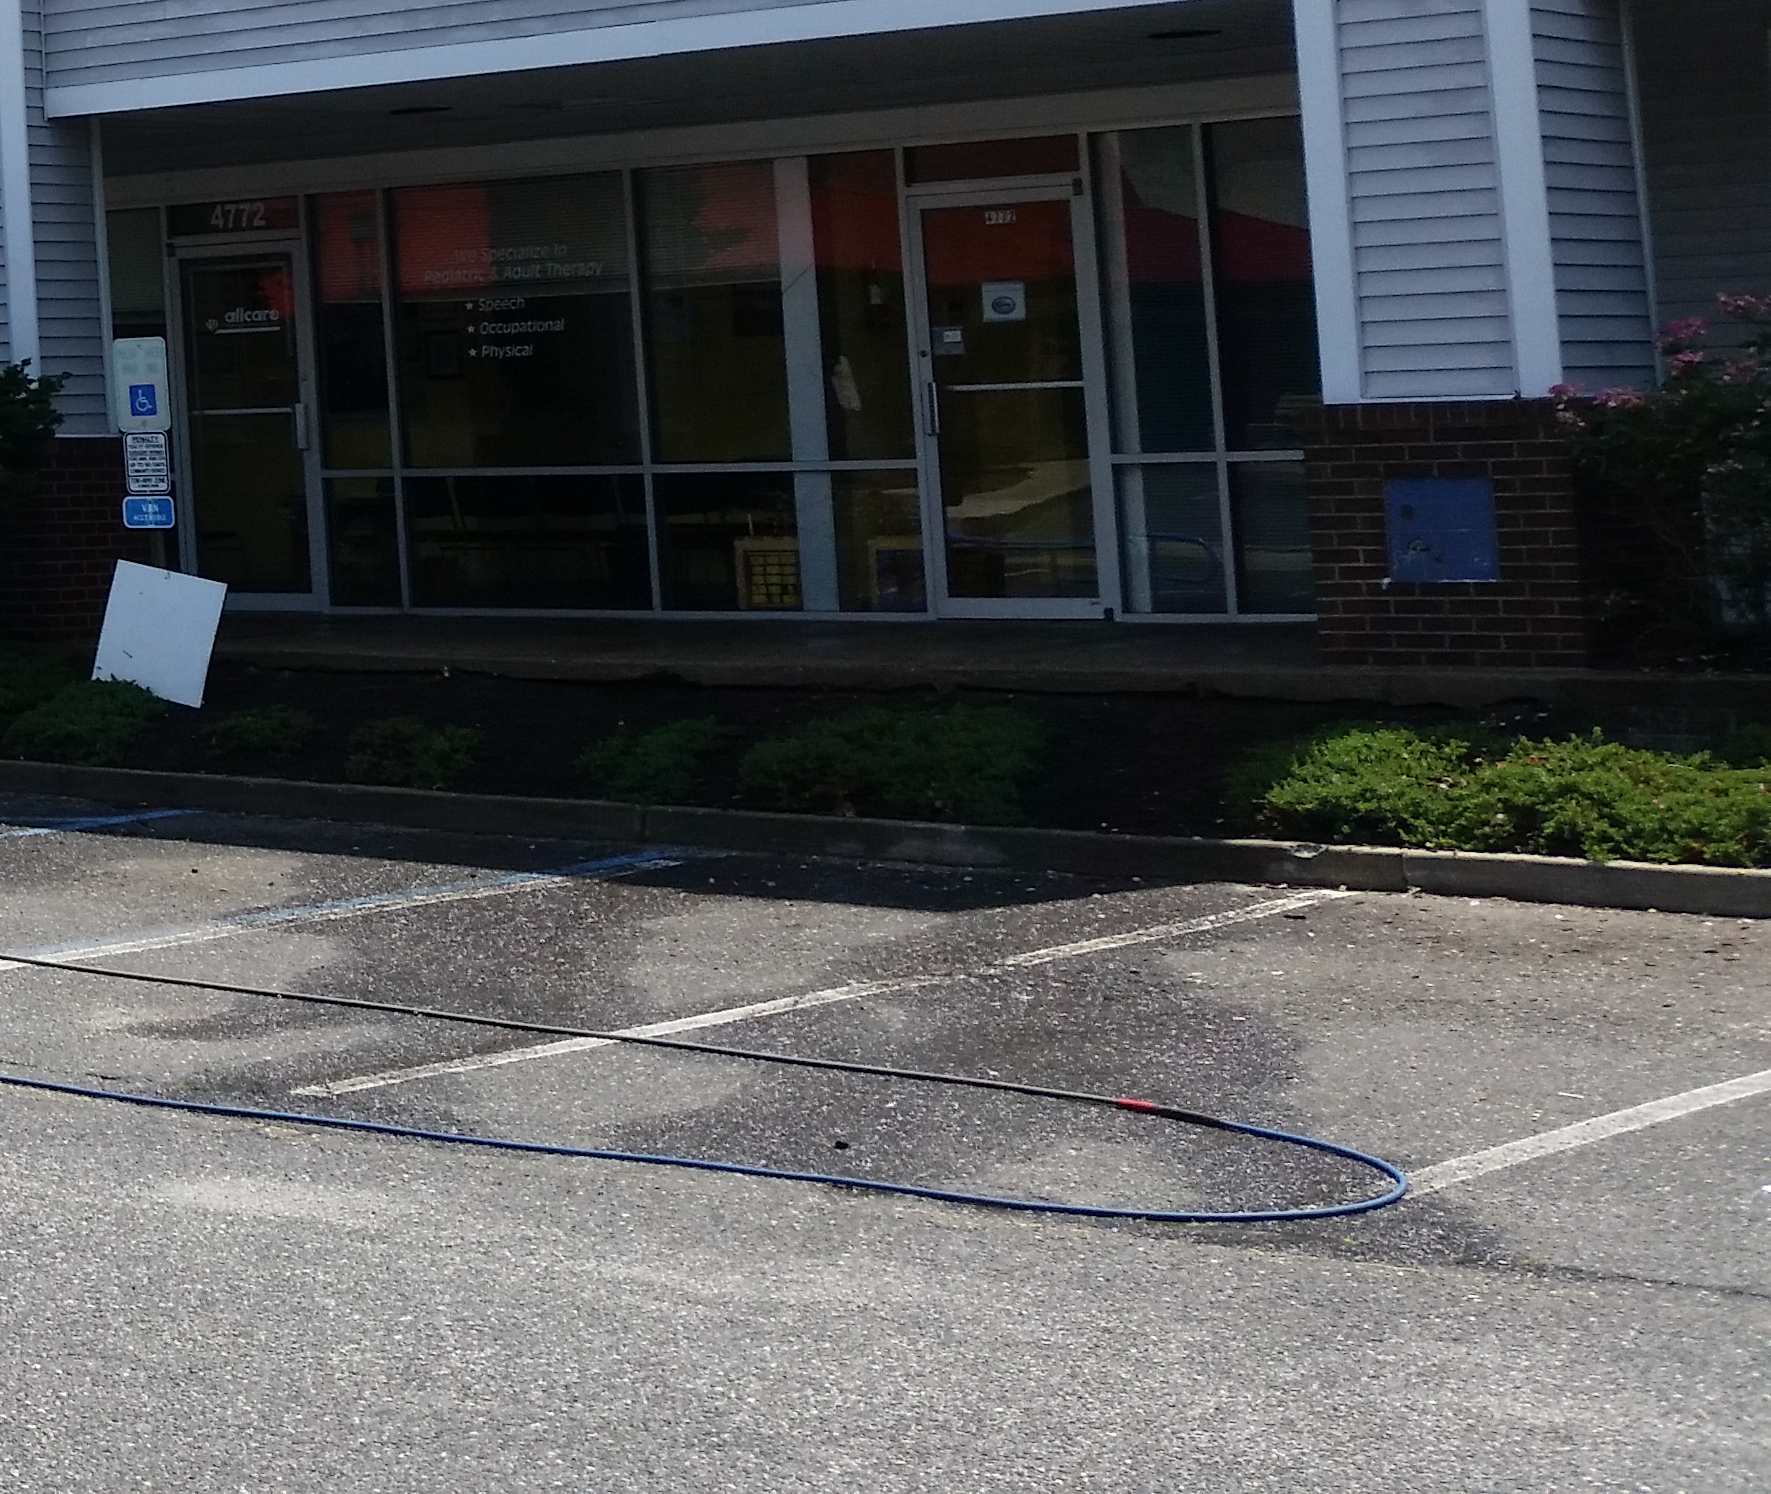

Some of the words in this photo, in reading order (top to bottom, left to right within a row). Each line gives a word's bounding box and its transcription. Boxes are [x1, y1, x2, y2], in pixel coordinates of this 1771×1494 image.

[211, 202, 266, 229] 4772
[456, 249, 477, 263] We
[481, 245, 550, 263] Specialize
[554, 243, 568, 256] in
[503, 263, 541, 279] Adult
[546, 260, 605, 278] Therapy
[479, 297, 526, 312] Speech
[225, 307, 279, 323] allcare
[479, 318, 565, 335] Occupational
[481, 343, 533, 359] Physical
[141, 503, 159, 512] VAN
